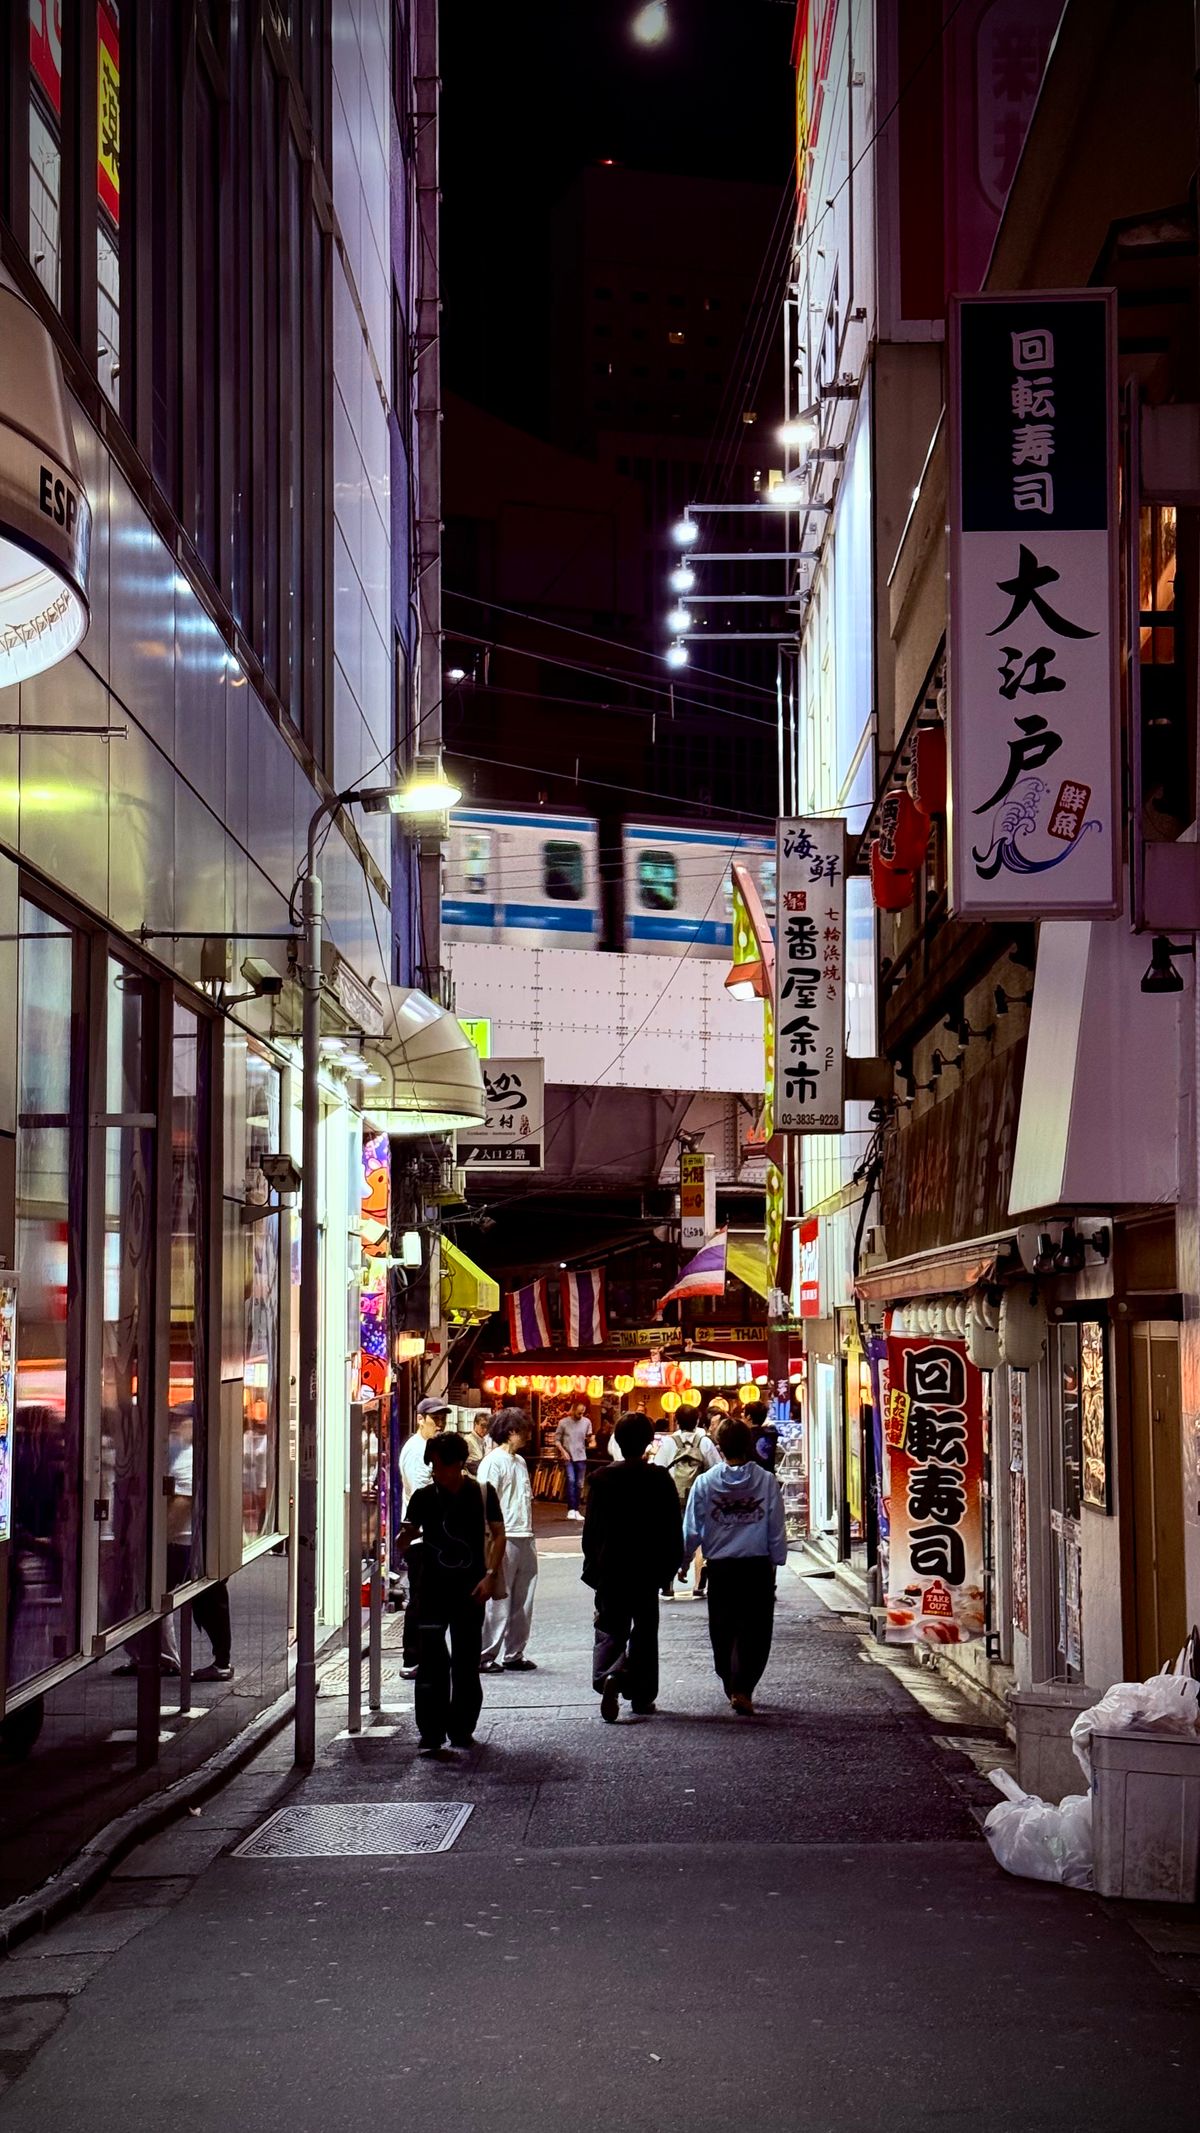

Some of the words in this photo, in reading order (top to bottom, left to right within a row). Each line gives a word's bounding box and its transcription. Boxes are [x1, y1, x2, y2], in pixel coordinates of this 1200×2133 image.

[1011, 328, 1055, 515] 回転寿司
[972, 543, 1100, 815] 大江戸
[1051, 784, 1088, 839] 鮮魚
[783, 828, 841, 888] 海鮮
[823, 908, 841, 1000] 七輪浜焼き
[780, 916, 821, 1104] 番屋余市
[824, 1046, 834, 1072] 2F
[782, 1113, 839, 1126] 03-3835-9228
[620, 1331, 637, 1345] THAI
[661, 1328, 682, 1342] THAI
[735, 1328, 763, 1341] THAI
[904, 1346, 967, 1586] 回転寿司
[926, 1594, 950, 1603] TAKE
[929, 1602, 948, 1611] OUT
